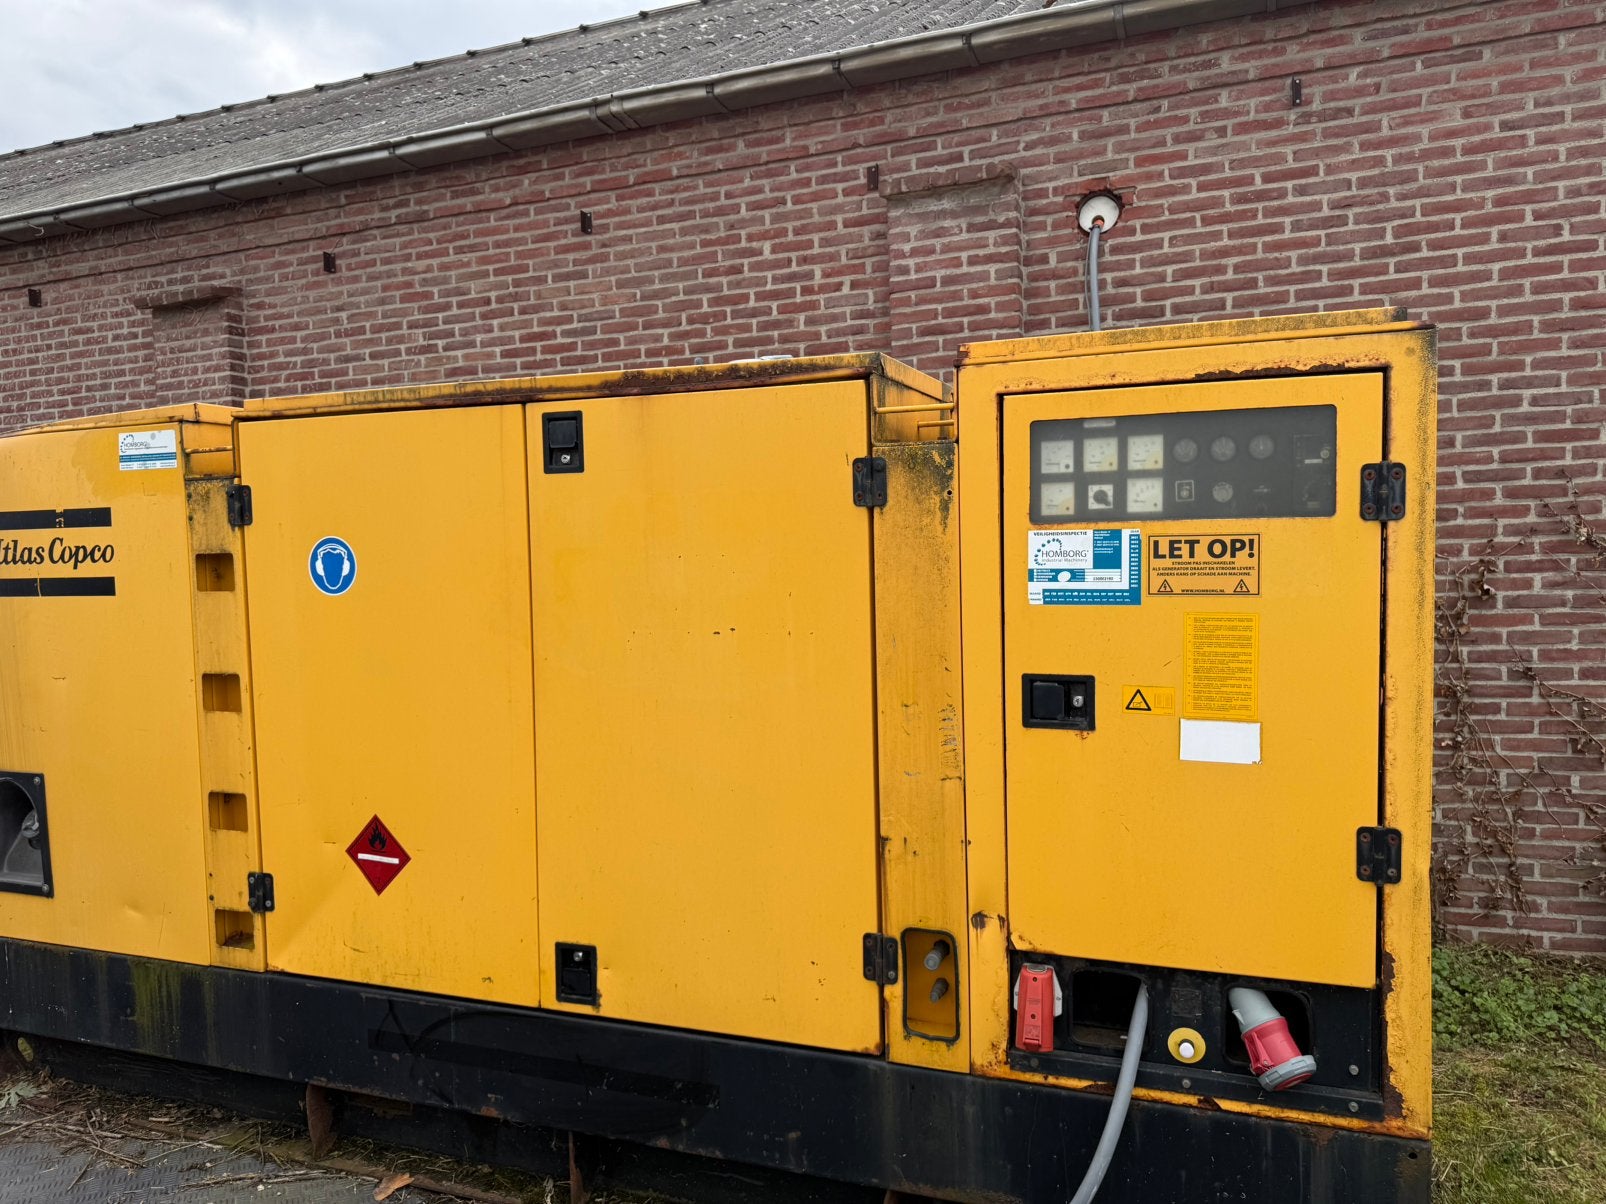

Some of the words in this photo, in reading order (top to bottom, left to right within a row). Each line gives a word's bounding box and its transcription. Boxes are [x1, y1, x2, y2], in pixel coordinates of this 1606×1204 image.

[48, 537, 115, 570] Copco
[1153, 539, 1200, 559] LET
[1207, 538, 1255, 559] OP!
